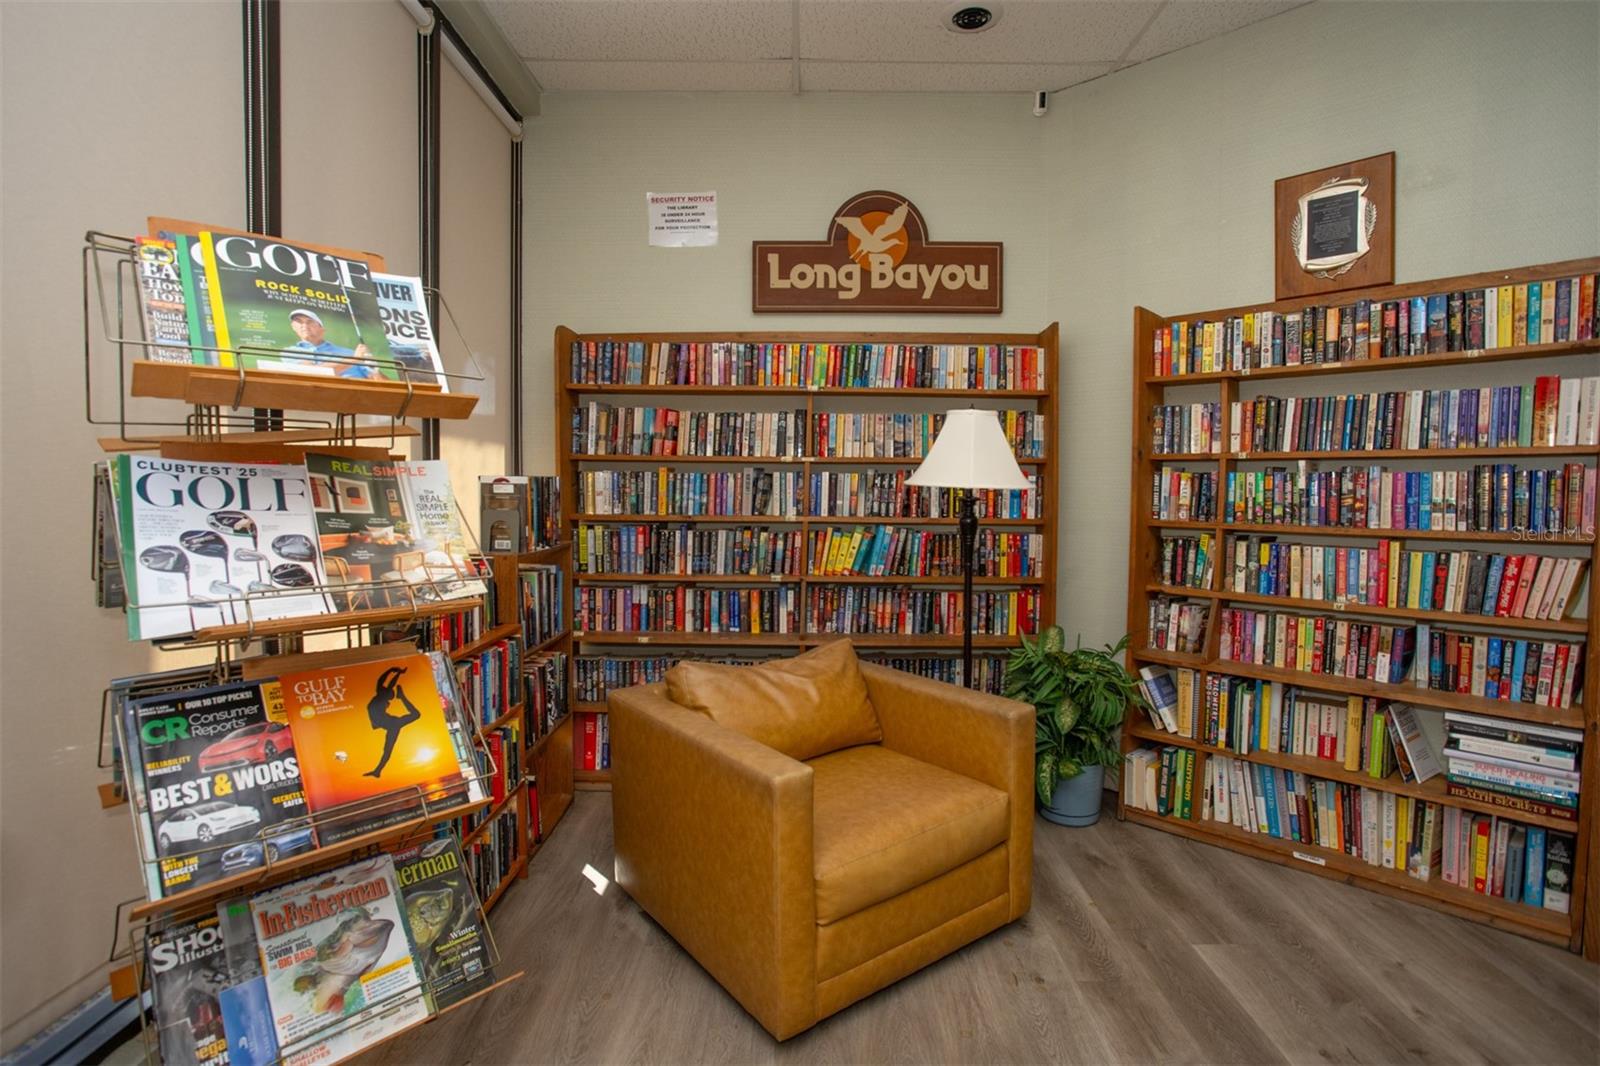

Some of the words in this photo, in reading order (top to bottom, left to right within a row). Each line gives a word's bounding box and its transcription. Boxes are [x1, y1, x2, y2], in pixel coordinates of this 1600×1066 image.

[651, 196, 686, 204] SECURITY
[215, 236, 368, 289] GOLF
[767, 253, 861, 300] Long
[869, 253, 990, 300] Bayou
[255, 279, 300, 295] ROCK
[305, 288, 350, 304] SOLID
[136, 460, 232, 475] CLUBTEST
[331, 460, 373, 476] REAL
[373, 466, 427, 477] SIMPLE
[136, 471, 306, 512] GOLF
[419, 495, 441, 503] REAL
[416, 503, 449, 512] SIMPLE
[420, 512, 449, 520] Home
[294, 676, 345, 696] GULF
[185, 699, 202, 710] OUR
[203, 698, 211, 708] 10
[212, 694, 227, 705] TOP
[296, 694, 312, 704] TO
[312, 688, 347, 706] BAY
[189, 704, 259, 726] Consumer
[141, 716, 191, 745] CR
[191, 718, 246, 738] Reports
[146, 755, 191, 771] RELIABILITY
[147, 765, 182, 777] WINNERS
[150, 776, 212, 812] BEST
[214, 773, 233, 797] &
[272, 792, 301, 804] SECRETS
[1450, 786, 1493, 803] HEALTH
[1494, 796, 1547, 815] SECRETS
[283, 797, 303, 808] SAFER
[184, 856, 198, 865] THE
[163, 864, 198, 879] LONGEST
[259, 876, 390, 941] In-Fisherman
[448, 924, 476, 941] Winter
[267, 945, 293, 961] SWIM
[295, 938, 313, 951] JIGS
[277, 957, 293, 970] BIG
[293, 946, 318, 963] BASS
